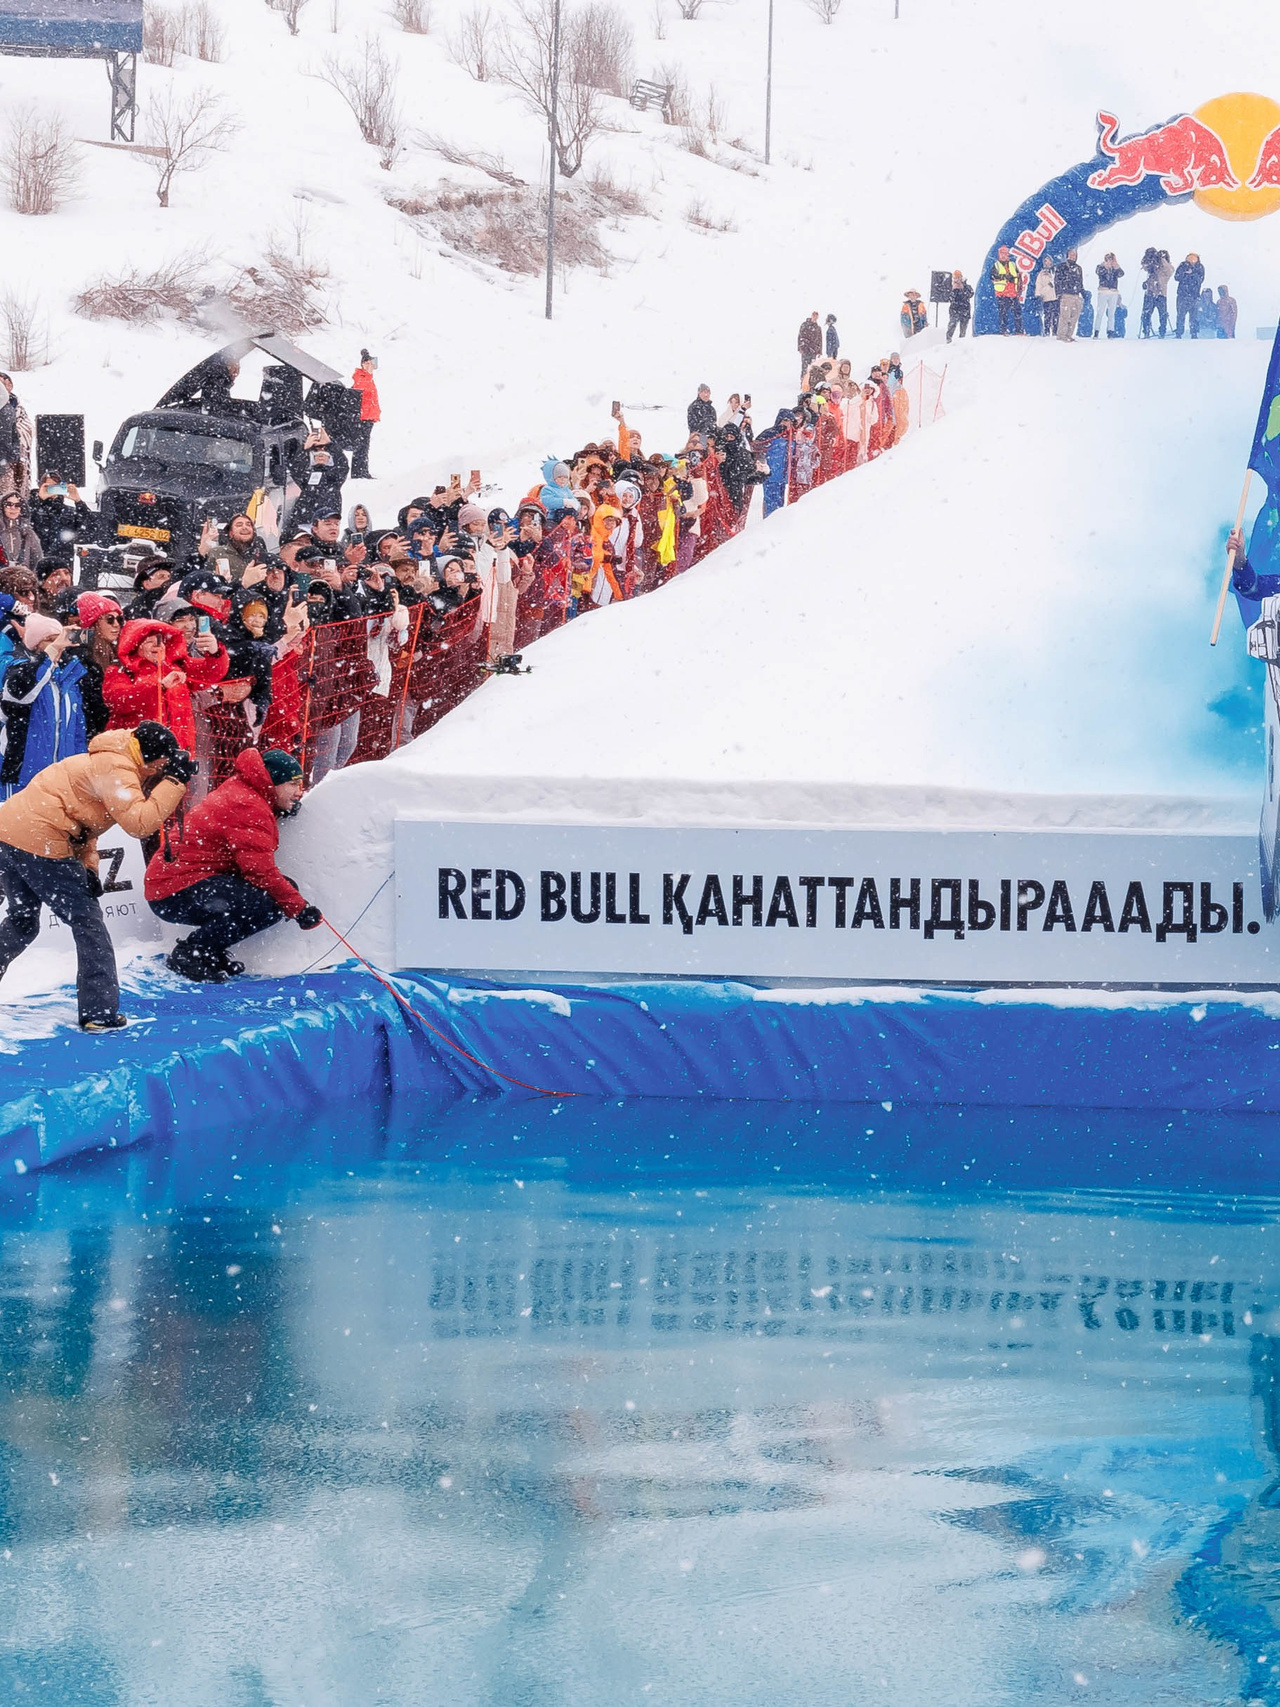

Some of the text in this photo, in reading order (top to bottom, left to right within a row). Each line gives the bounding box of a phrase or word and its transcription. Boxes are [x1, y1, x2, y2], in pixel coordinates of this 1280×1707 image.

[438, 867, 1261, 943] RED BULL ҚАНАТТАНДЫРАААДЫ.
